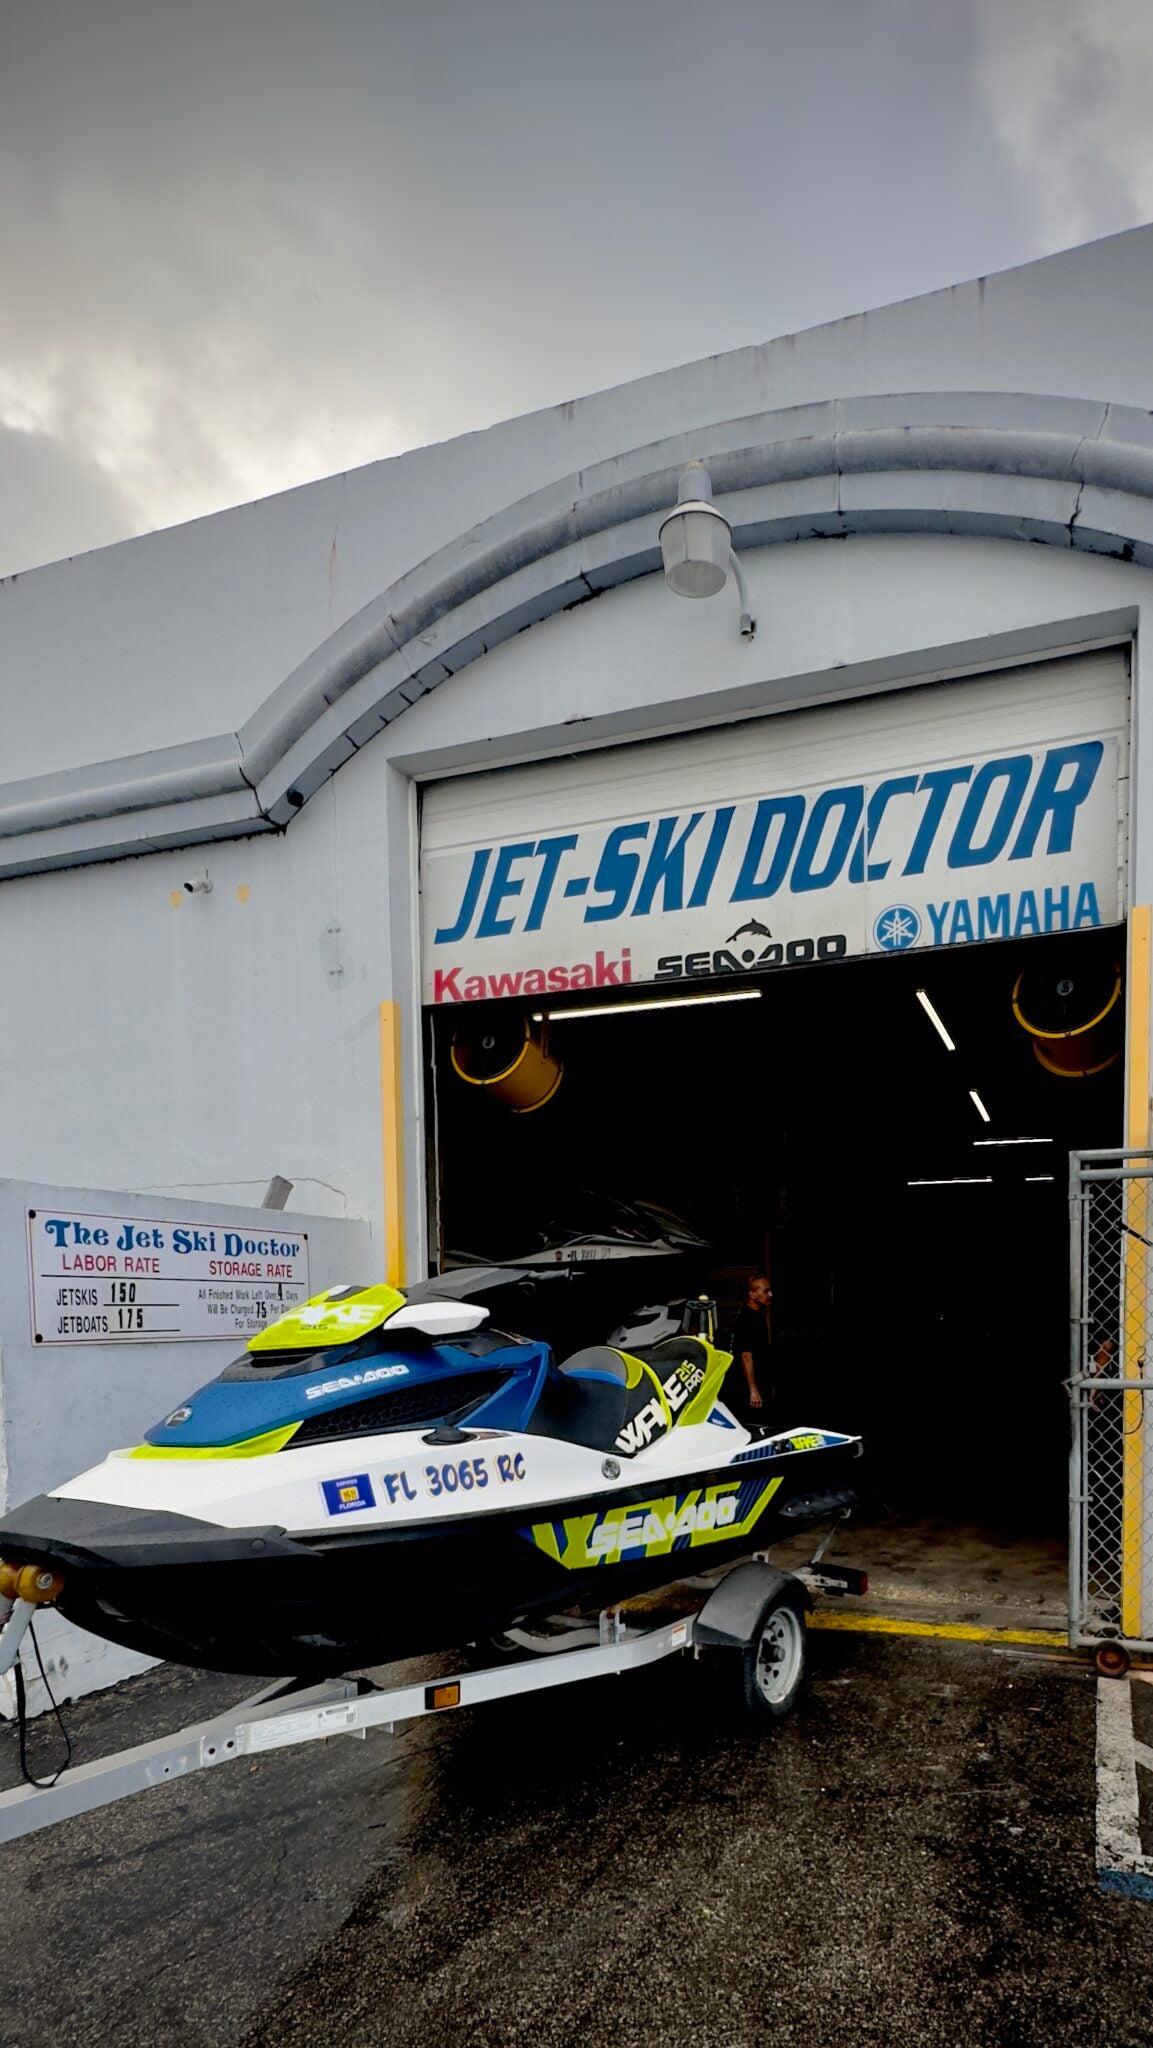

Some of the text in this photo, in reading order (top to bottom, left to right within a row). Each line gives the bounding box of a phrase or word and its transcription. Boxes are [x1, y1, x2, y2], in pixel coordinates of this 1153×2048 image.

[434, 740, 1104, 944] JET-SKI DOCTOR
[927, 882, 1100, 946] YAMAHA
[434, 948, 632, 1003] Kawasaki
[45, 1219, 300, 1257] The Jet Ski Doctor
[62, 1253, 160, 1273] LABOR RATE
[209, 1260, 293, 1278] STORAGE RATE
[56, 1282, 136, 1306] JETSKIS 150
[198, 1288, 207, 1299] All
[209, 1288, 234, 1300] Finished
[235, 1289, 250, 1300] Work
[252, 1289, 263, 1301] Left
[286, 1290, 299, 1303] Days
[57, 1308, 143, 1334] JETBOATS 175
[207, 1303, 219, 1315] Will
[220, 1303, 228, 1315] Be
[230, 1303, 254, 1317] Charged
[256, 1301, 267, 1319] 75
[235, 1318, 244, 1329] For
[674, 1359, 697, 1383] 215
[684, 1368, 706, 1392] PRO
[383, 1471, 417, 1505] FL
[425, 1457, 489, 1497] 3065
[496, 1452, 526, 1483] RC
[339, 1499, 367, 1510] FLORIDA
